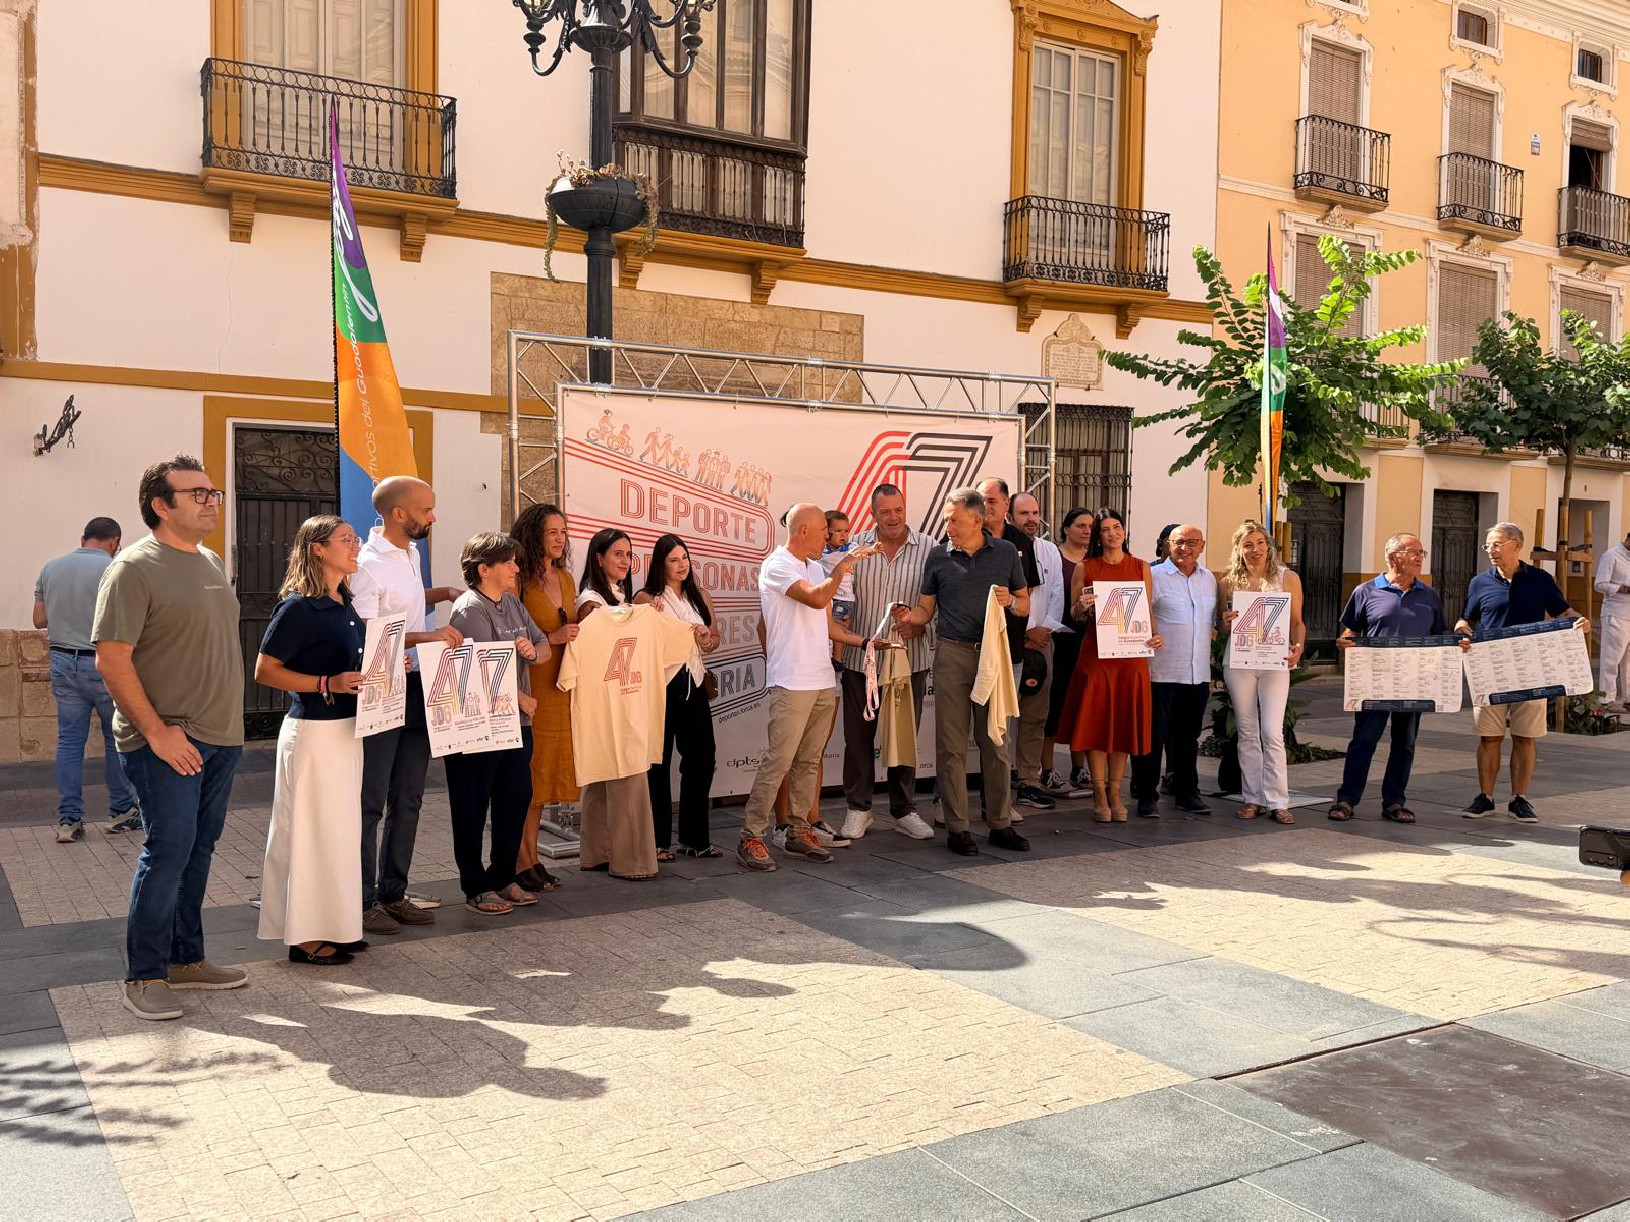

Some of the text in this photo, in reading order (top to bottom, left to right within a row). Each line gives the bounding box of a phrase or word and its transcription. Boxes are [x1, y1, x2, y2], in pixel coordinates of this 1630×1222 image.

[361, 398, 374, 428] del
[620, 478, 756, 544] DEPORTE
[1233, 597, 1289, 644] 47
[1235, 634, 1254, 647] JDG
[427, 645, 473, 716] 47
